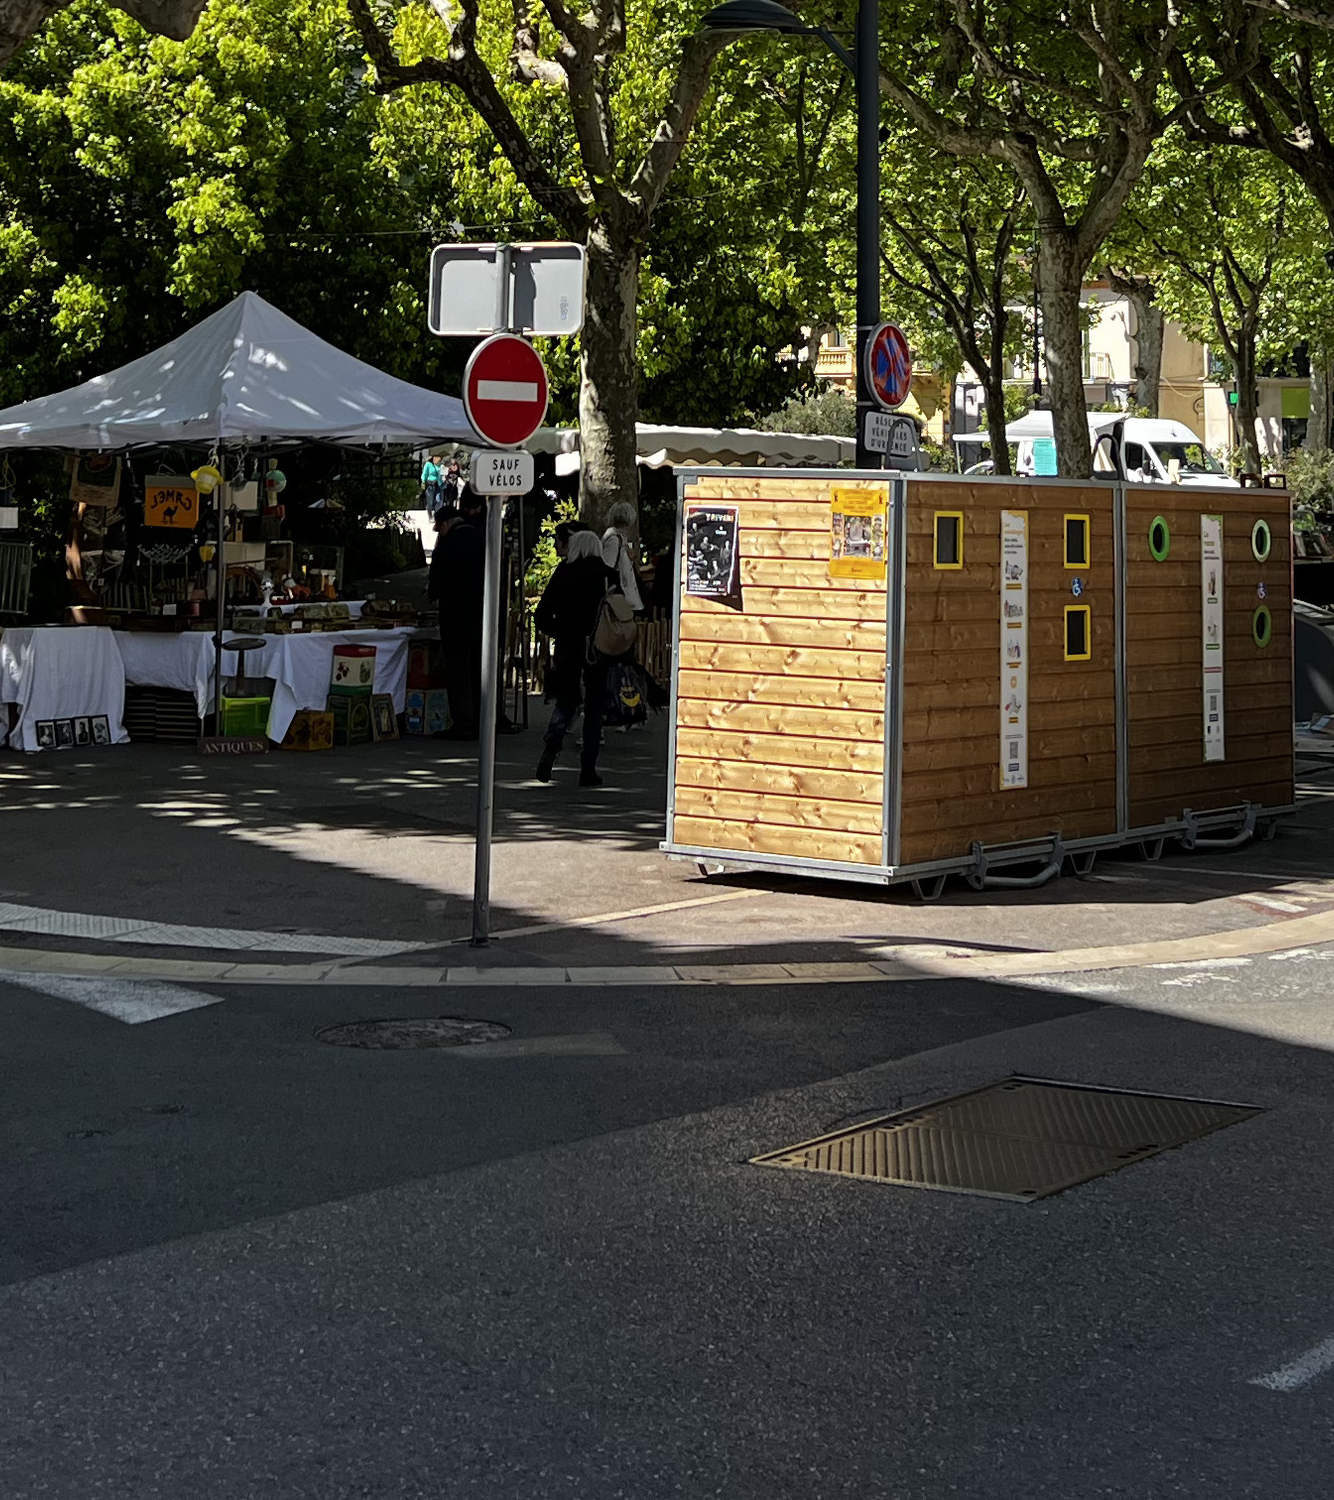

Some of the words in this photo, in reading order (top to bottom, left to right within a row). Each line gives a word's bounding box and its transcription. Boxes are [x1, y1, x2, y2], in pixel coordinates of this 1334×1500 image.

[872, 426, 907, 441] VÉHILES
[871, 438, 907, 452] D'URNCE
[492, 459, 520, 470] SAUF
[489, 472, 522, 486] VÉLOS
[203, 741, 264, 754] ANTIQUES
